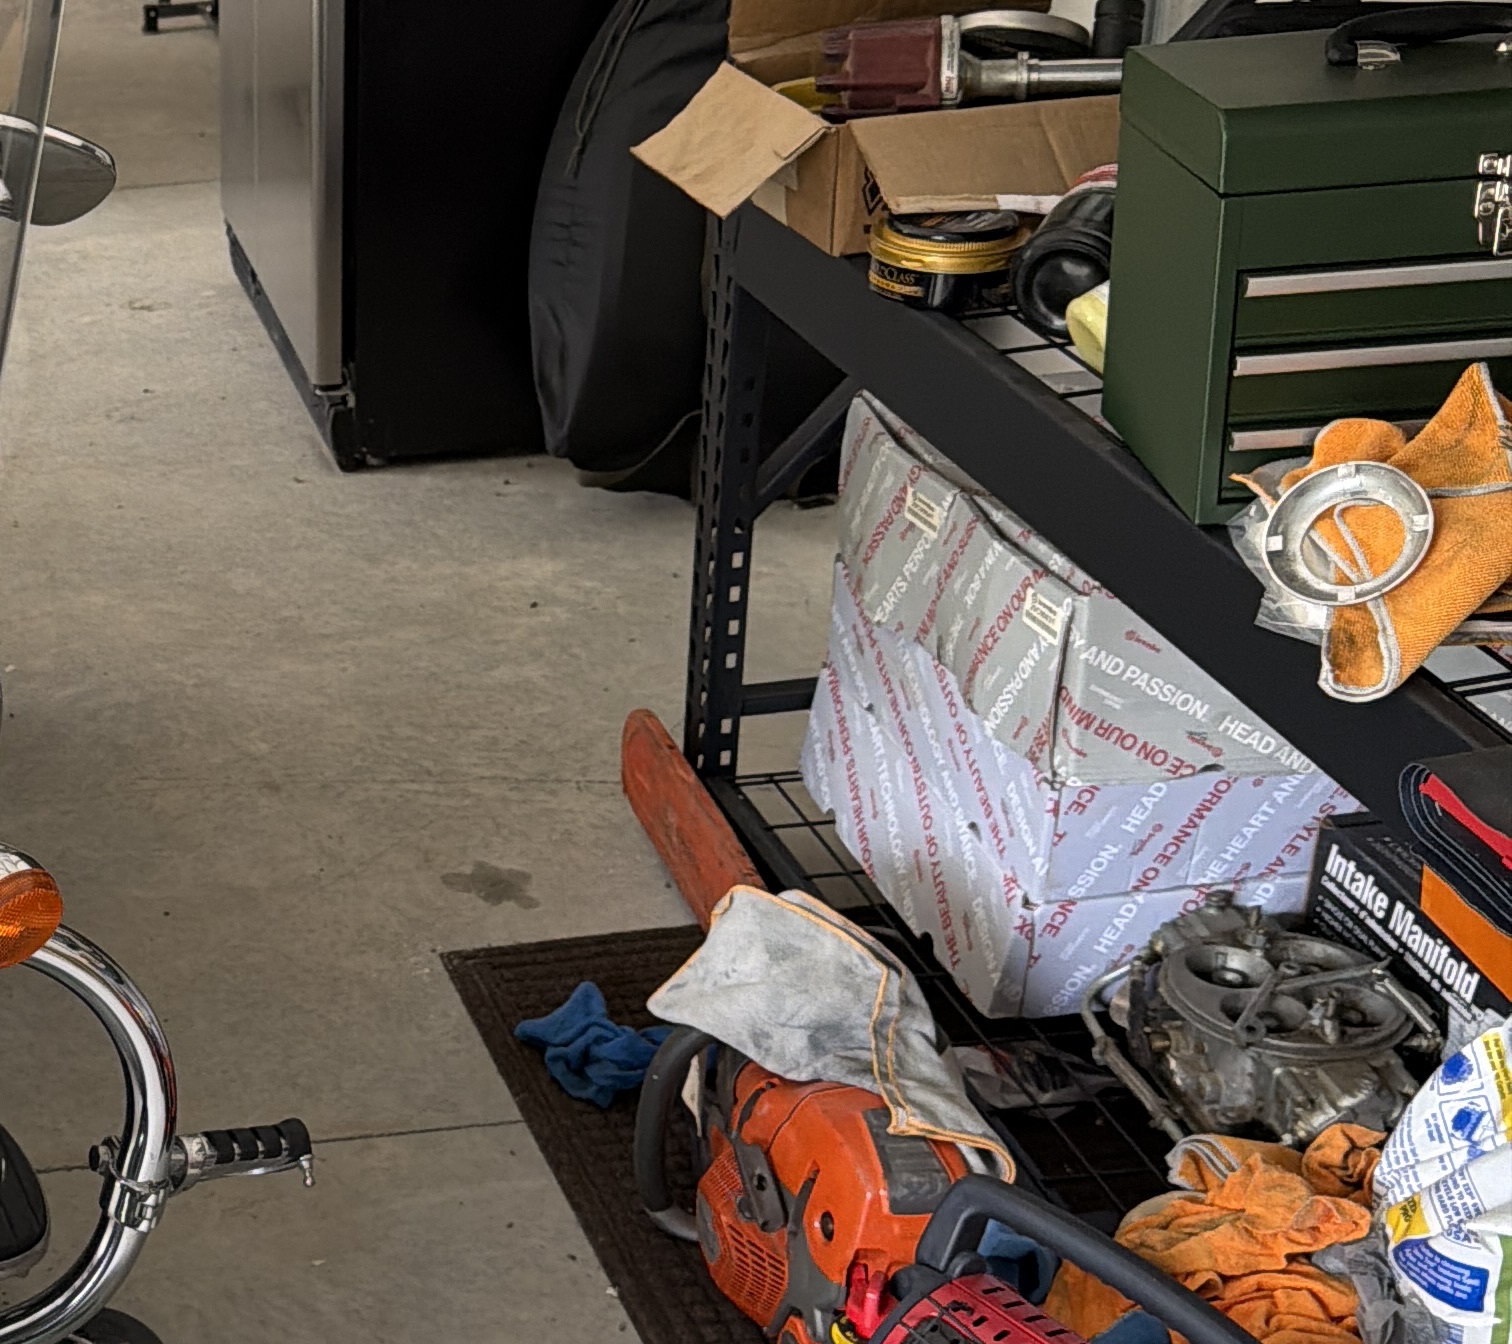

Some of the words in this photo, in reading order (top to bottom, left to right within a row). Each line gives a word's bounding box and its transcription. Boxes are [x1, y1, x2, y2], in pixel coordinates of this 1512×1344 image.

[1080, 645, 1123, 676] AND
[1120, 664, 1211, 724] PASSION.
[1218, 714, 1279, 756] HEAD
[1095, 721, 1139, 753] OUR
[1137, 741, 1171, 769] ON
[1119, 781, 1168, 834] HEAD
[1226, 801, 1271, 862] HEART
[1093, 899, 1137, 955] HEAD
[1324, 843, 1389, 919] Intake
[1388, 900, 1481, 1004] Manifold
